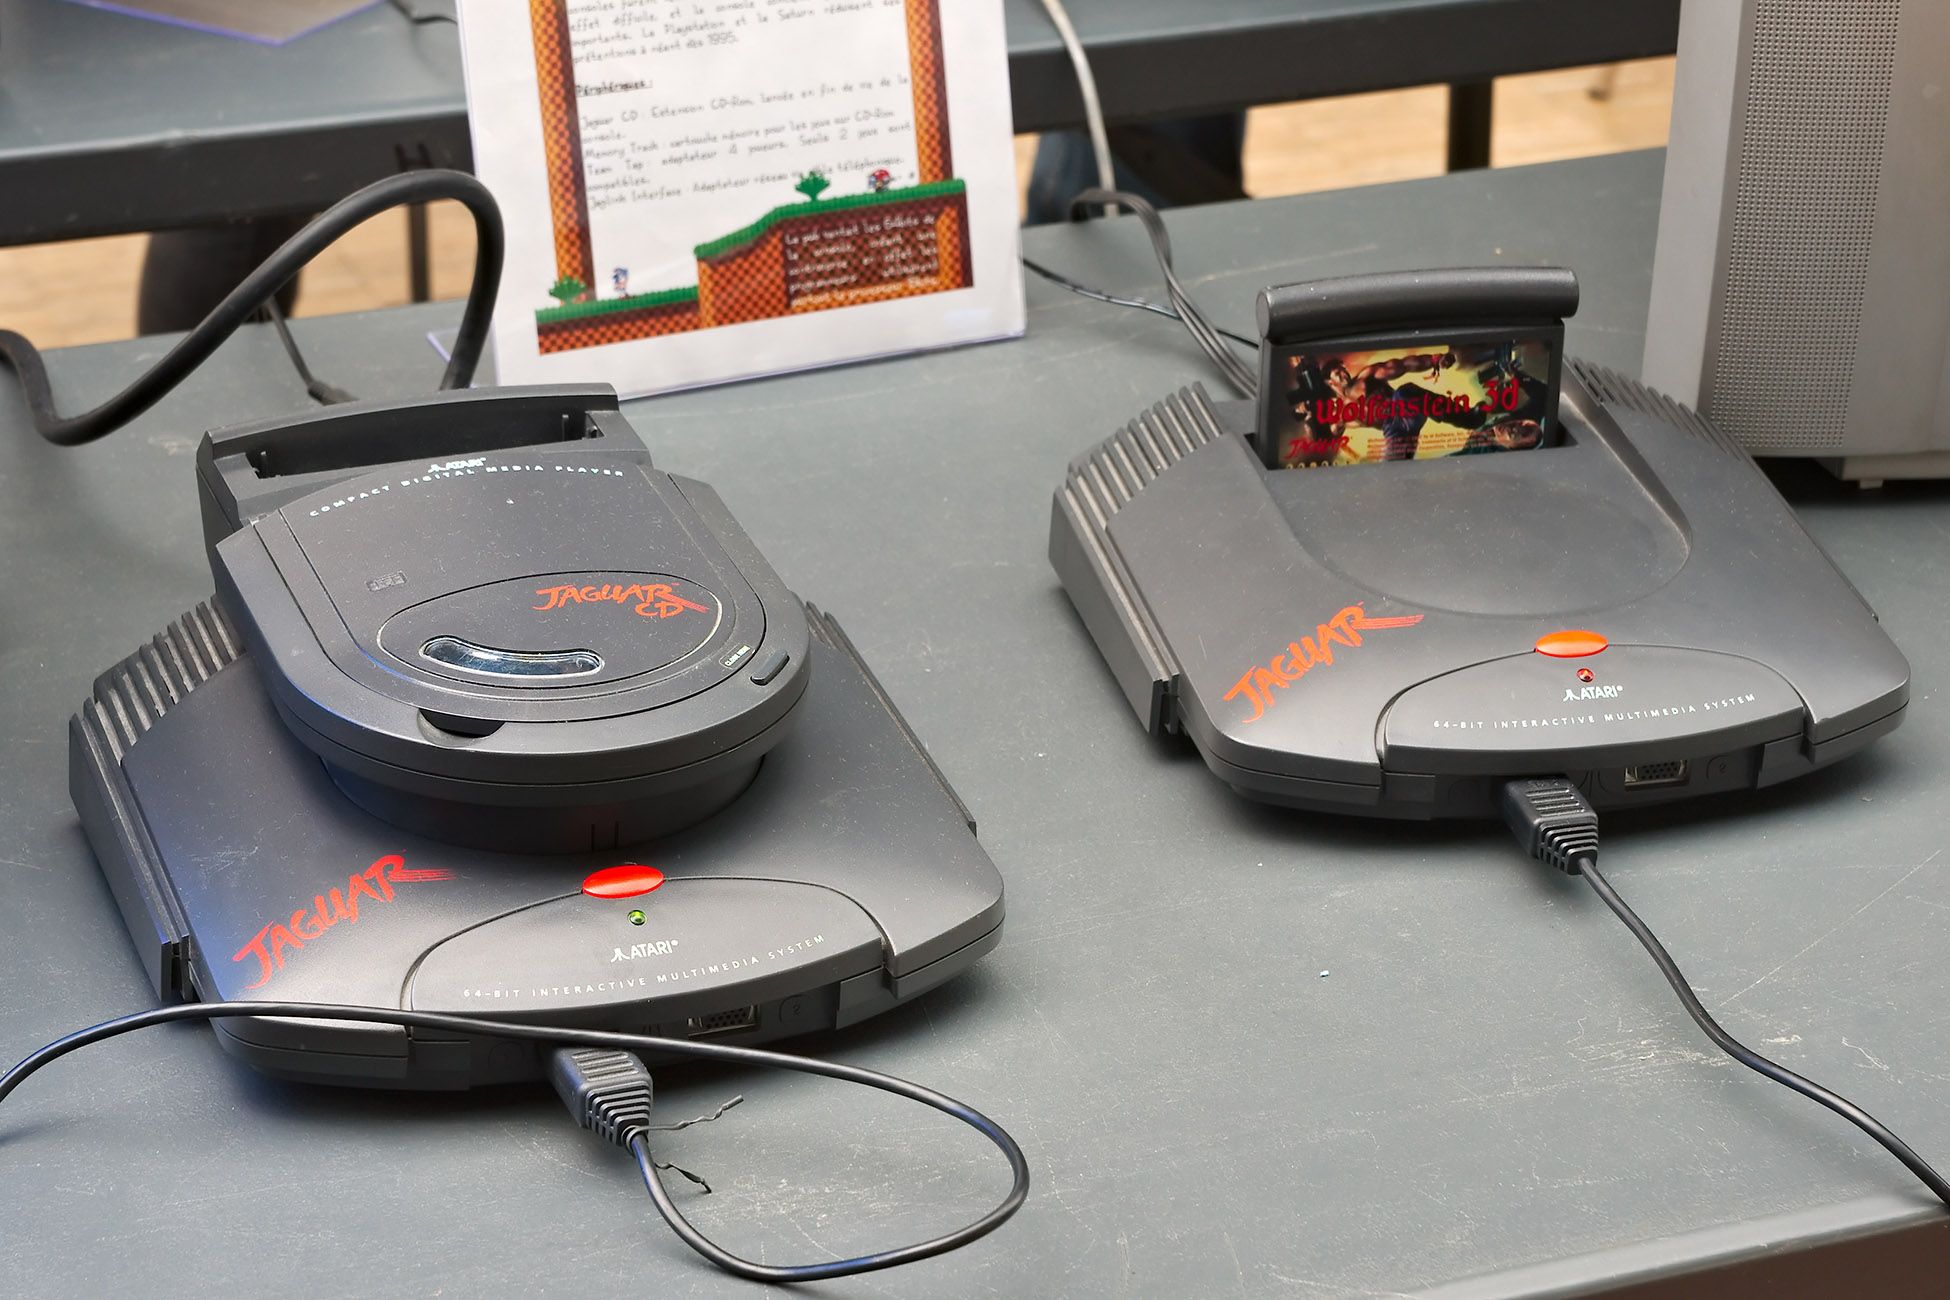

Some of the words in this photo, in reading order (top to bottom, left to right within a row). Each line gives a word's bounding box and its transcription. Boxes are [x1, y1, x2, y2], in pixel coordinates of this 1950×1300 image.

[840, 129, 848, 140] 2
[1315, 389, 1470, 425] Wolfenstein
[1480, 377, 1519, 412] 3d
[310, 486, 390, 517] COMPACT
[401, 469, 475, 487] DIGITAL
[486, 465, 543, 473] MEDIA
[556, 466, 624, 476] PLAYER
[533, 582, 709, 614] JAGUAR
[635, 602, 687, 619] CD
[1222, 602, 1424, 724] JAGUAR
[1433, 718, 1484, 730] 64-BIT
[1494, 715, 1595, 729] INTERACTIVE
[1604, 704, 1696, 723] MULTIMEDIA
[1704, 693, 1756, 712] SYSTEM
[232, 851, 457, 989] JAGUAR
[463, 987, 521, 999] 64-BIT
[532, 977, 647, 998] INTERACTIVE
[657, 955, 760, 984] MULTIMEDIA
[768, 933, 825, 961] SYSTEM
